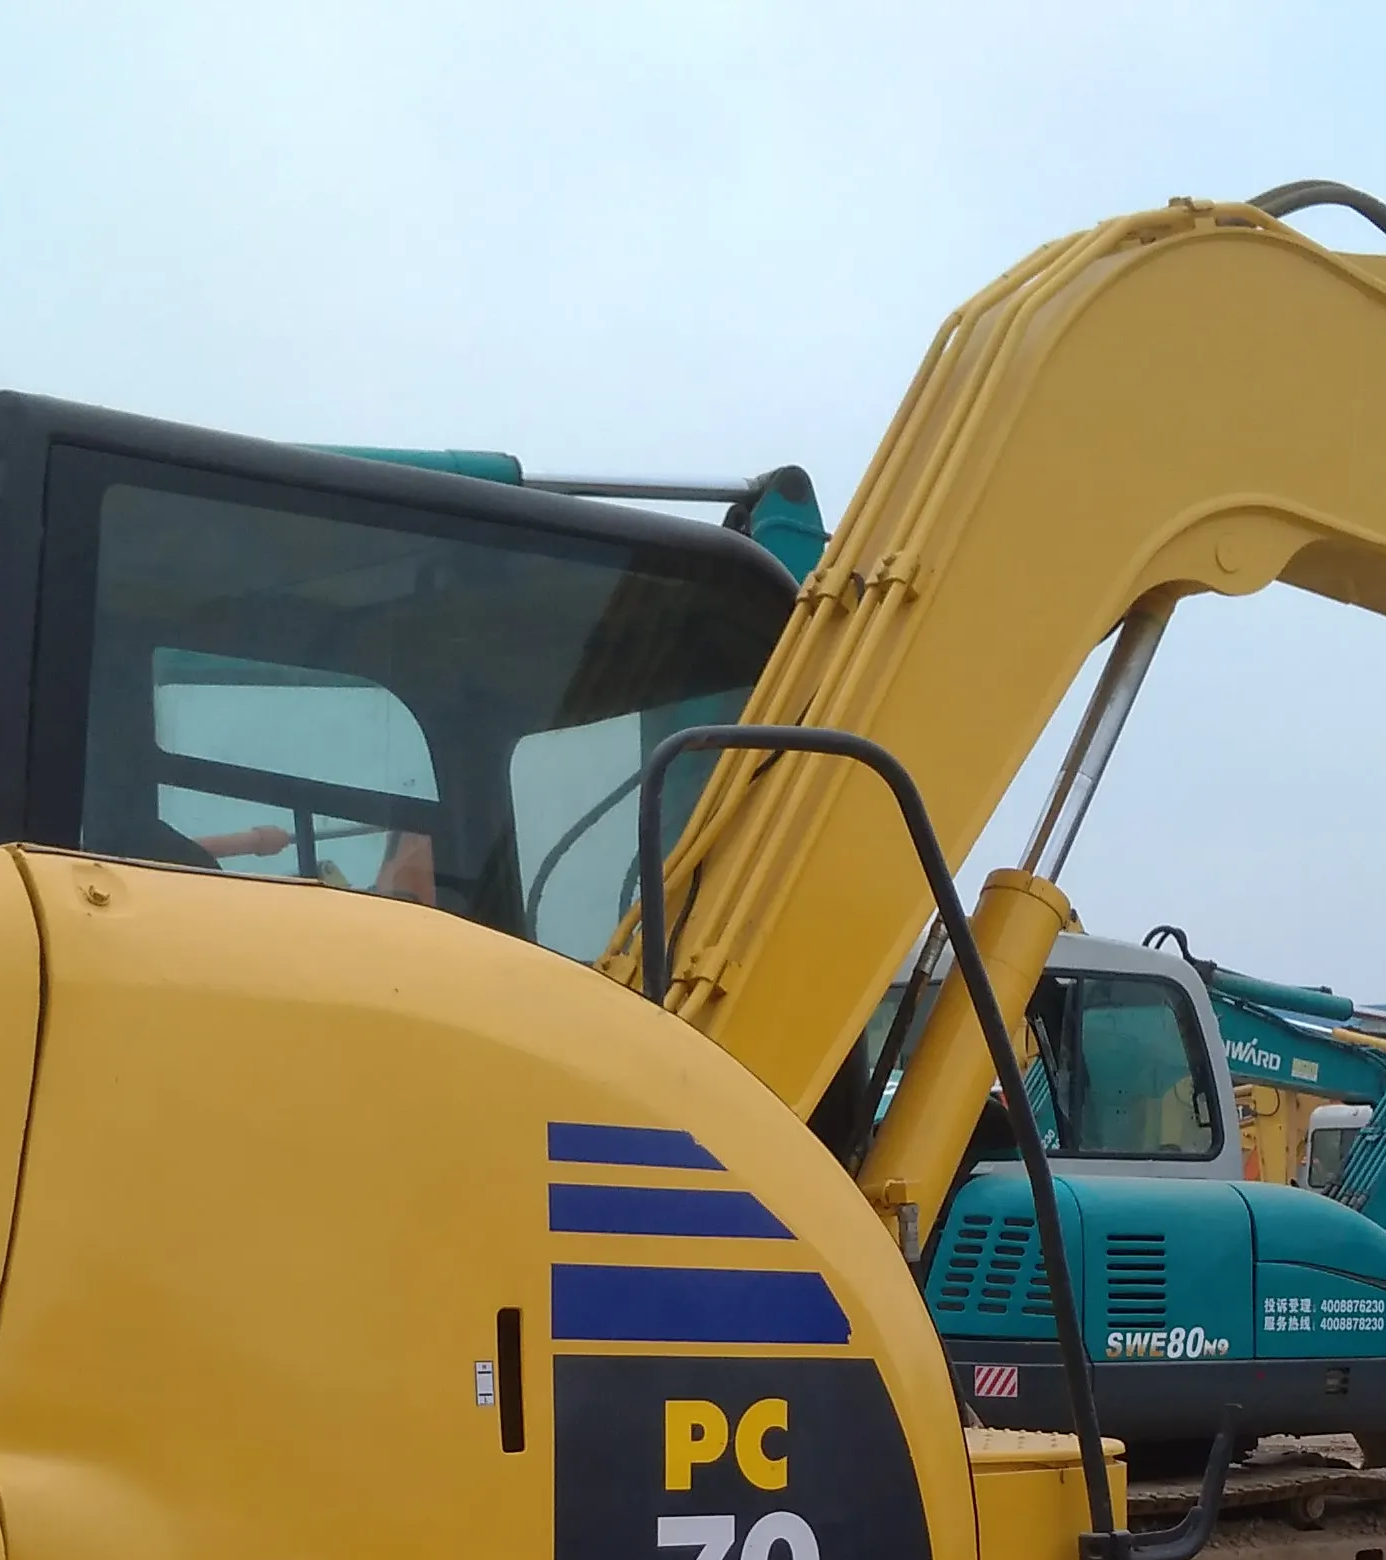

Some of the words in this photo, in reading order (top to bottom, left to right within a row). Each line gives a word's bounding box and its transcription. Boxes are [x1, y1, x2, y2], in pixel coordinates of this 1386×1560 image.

[1320, 1299, 1386, 1313] 4008876230
[1319, 1317, 1385, 1331] 4008878230
[665, 1398, 788, 1490] PC
